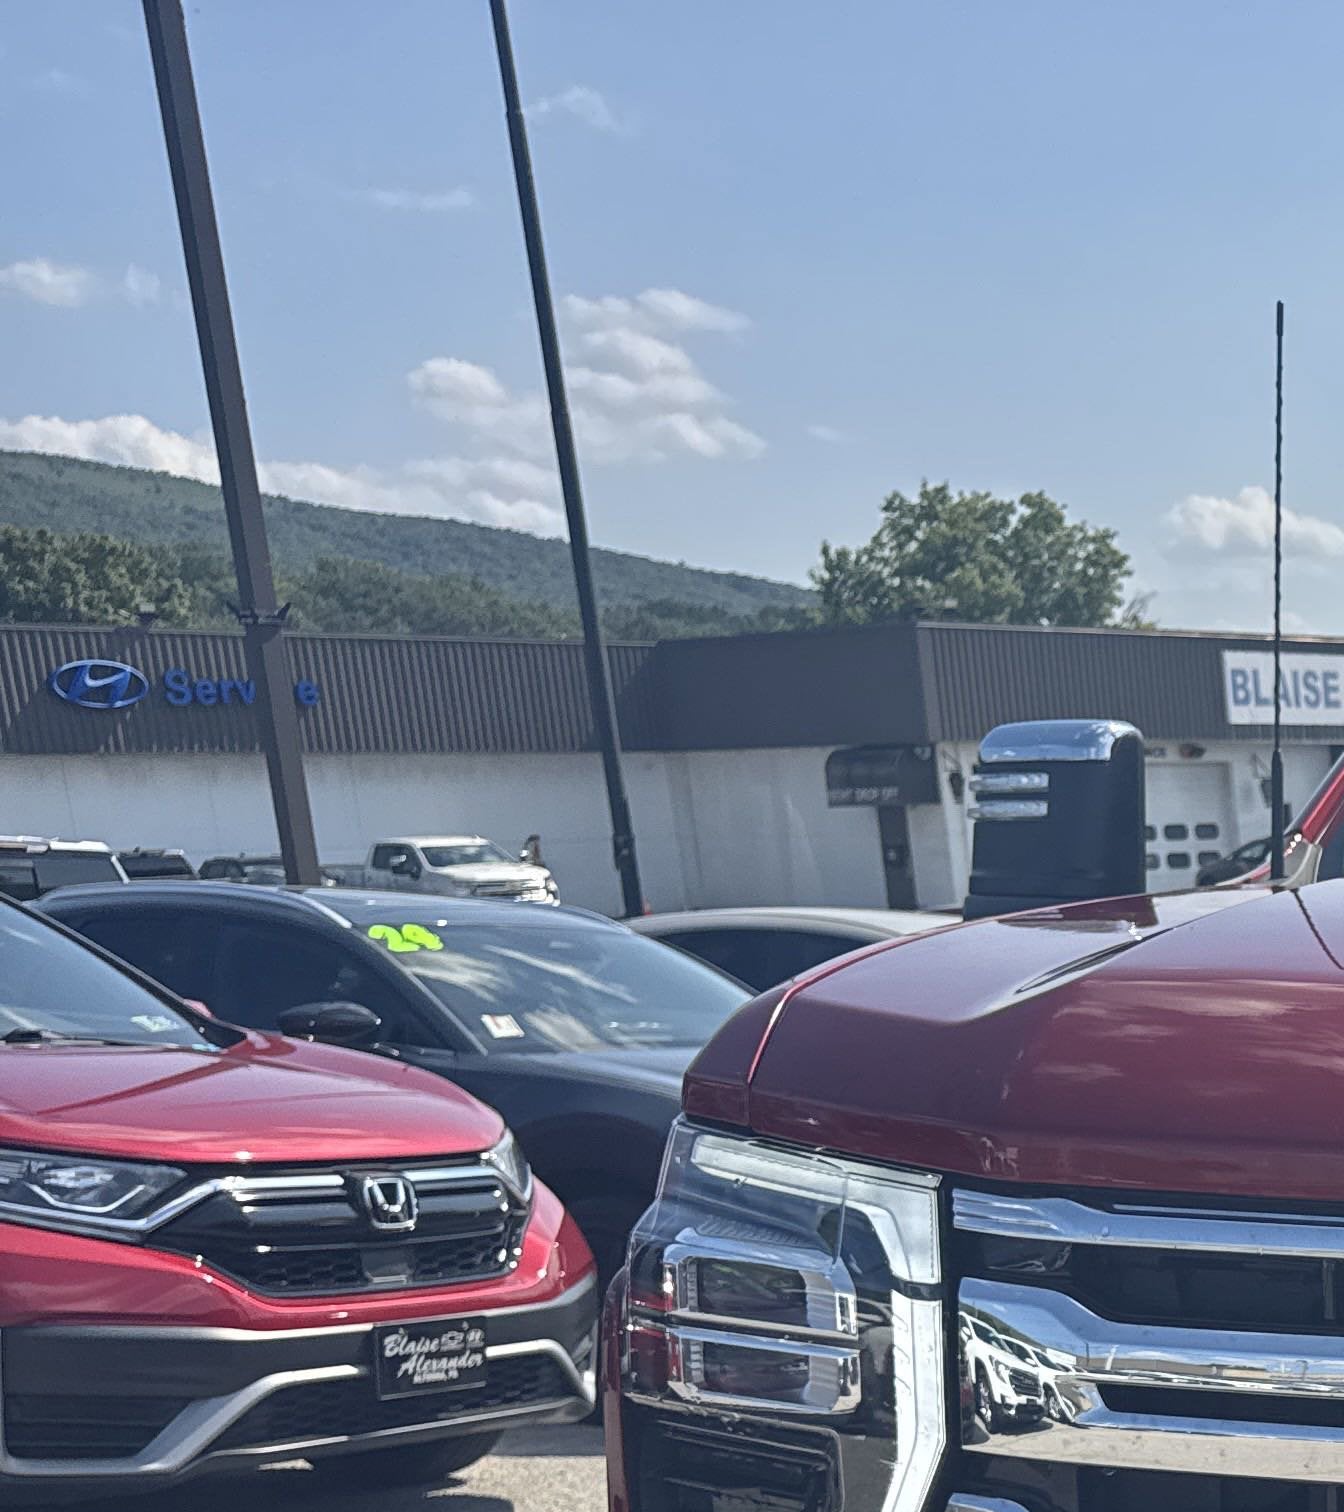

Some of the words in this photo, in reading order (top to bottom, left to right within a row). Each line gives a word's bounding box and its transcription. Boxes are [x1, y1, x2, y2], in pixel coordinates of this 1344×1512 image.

[163, 667, 321, 707] Serve
[1230, 668, 1343, 710] BLAISE
[383, 1331, 440, 1358] Blaise
[395, 1349, 484, 1380] Alexander
